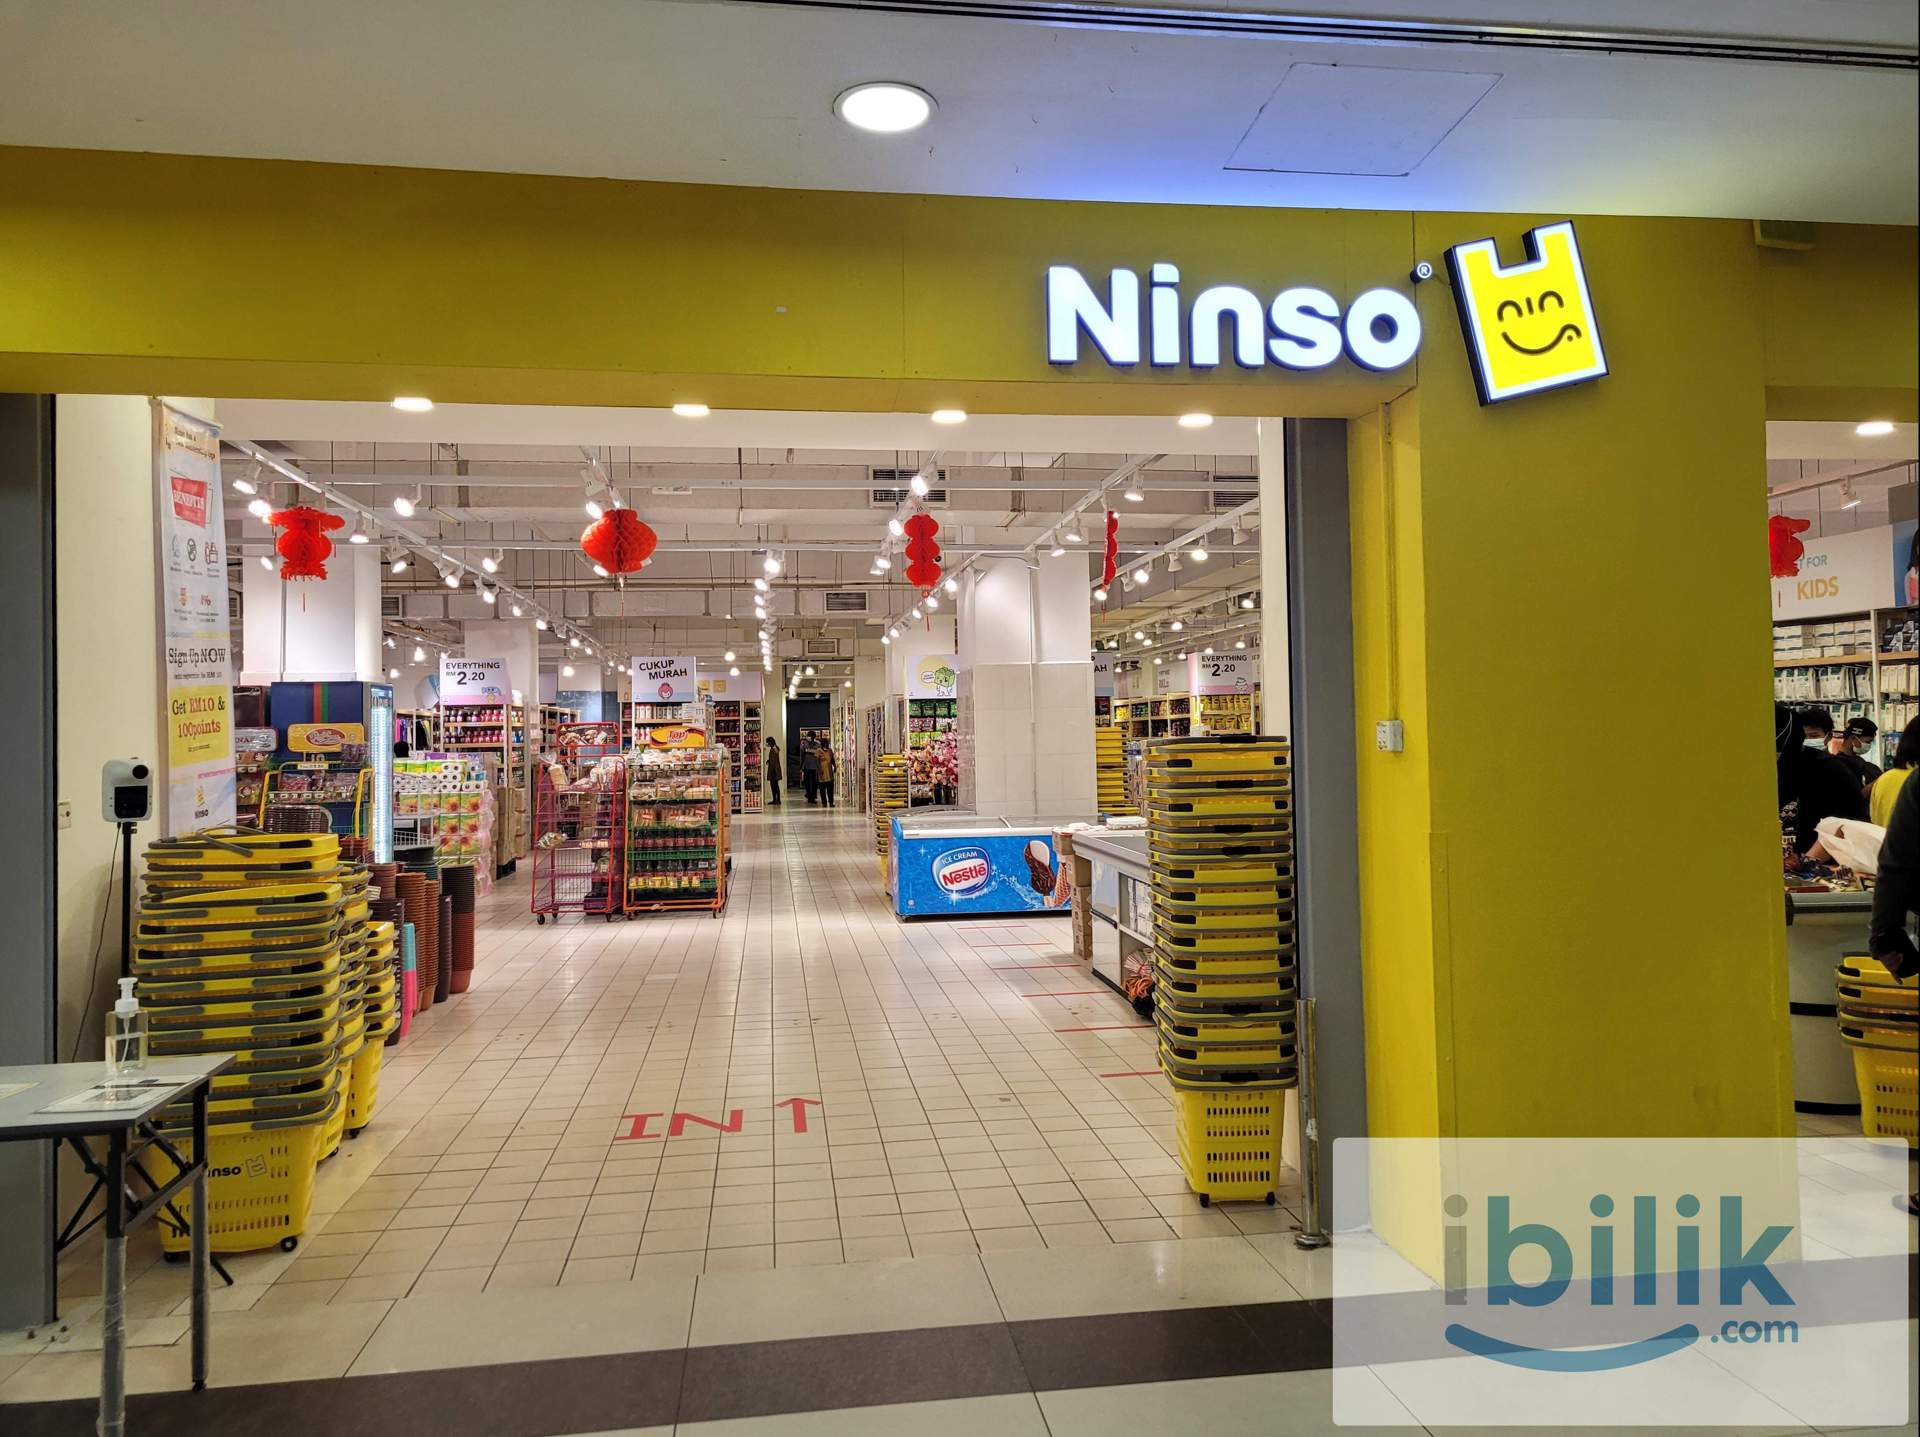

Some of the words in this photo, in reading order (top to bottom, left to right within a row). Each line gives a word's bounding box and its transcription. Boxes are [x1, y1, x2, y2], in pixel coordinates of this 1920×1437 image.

[1048, 263, 1422, 370] Ninso
[1807, 554, 1828, 568] FOR
[1797, 576, 1840, 601] KIDS
[168, 648, 188, 668] Sign
[189, 648, 200, 668] Up
[200, 647, 226, 663] NOW
[446, 662, 500, 670] EVERYTHING
[639, 659, 675, 671] CUKUP
[1212, 663, 1236, 677] 2.20
[457, 671, 485, 685] 2.20
[648, 668, 688, 680] MURAH
[172, 699, 186, 715] Get
[189, 697, 215, 714] RM10
[217, 696, 225, 711] &
[178, 720, 221, 740] 100points
[942, 856, 953, 865] ICE
[953, 851, 978, 860] CREAM
[614, 1109, 744, 1140] IN
